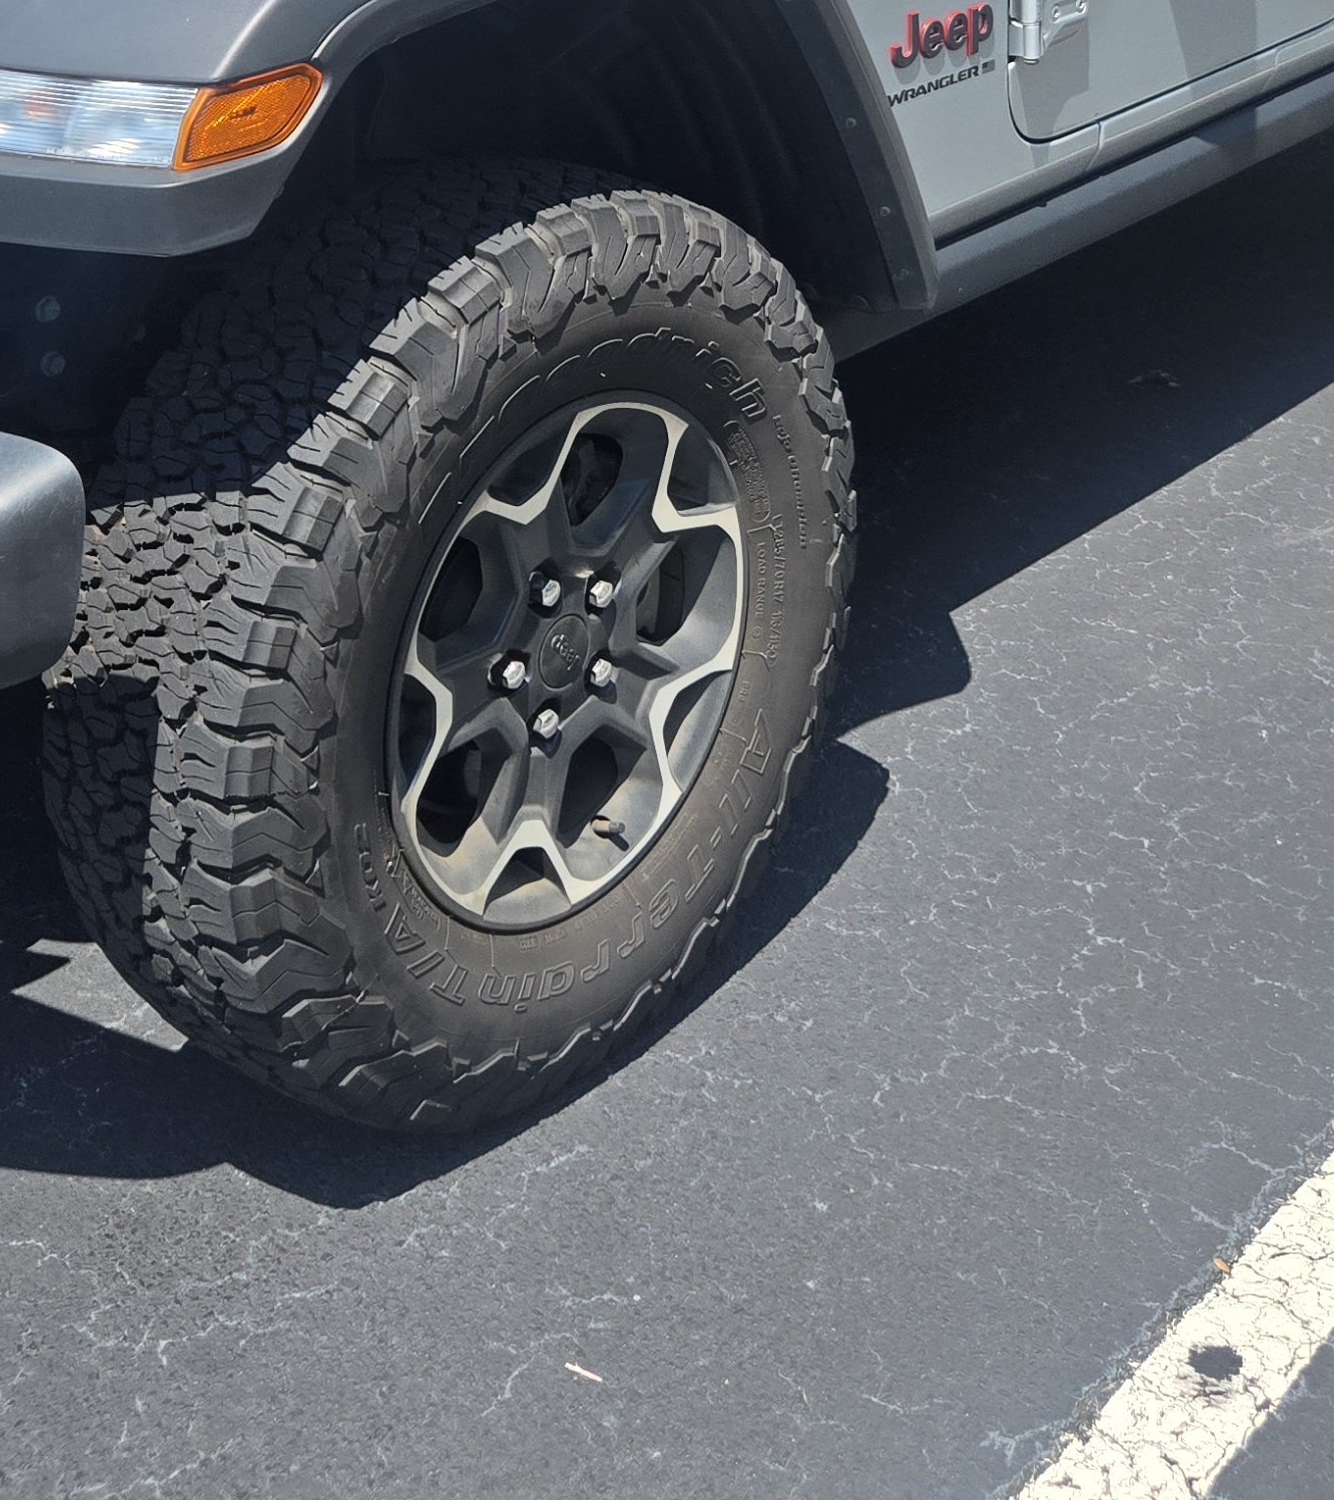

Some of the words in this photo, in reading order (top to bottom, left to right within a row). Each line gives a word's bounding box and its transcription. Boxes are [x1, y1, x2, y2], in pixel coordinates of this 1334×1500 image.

[889, 0, 995, 69] Jeep
[886, 65, 979, 107] WRANGLER
[478, 707, 772, 1013] All-Terrain
[383, 902, 470, 1005] T/A
